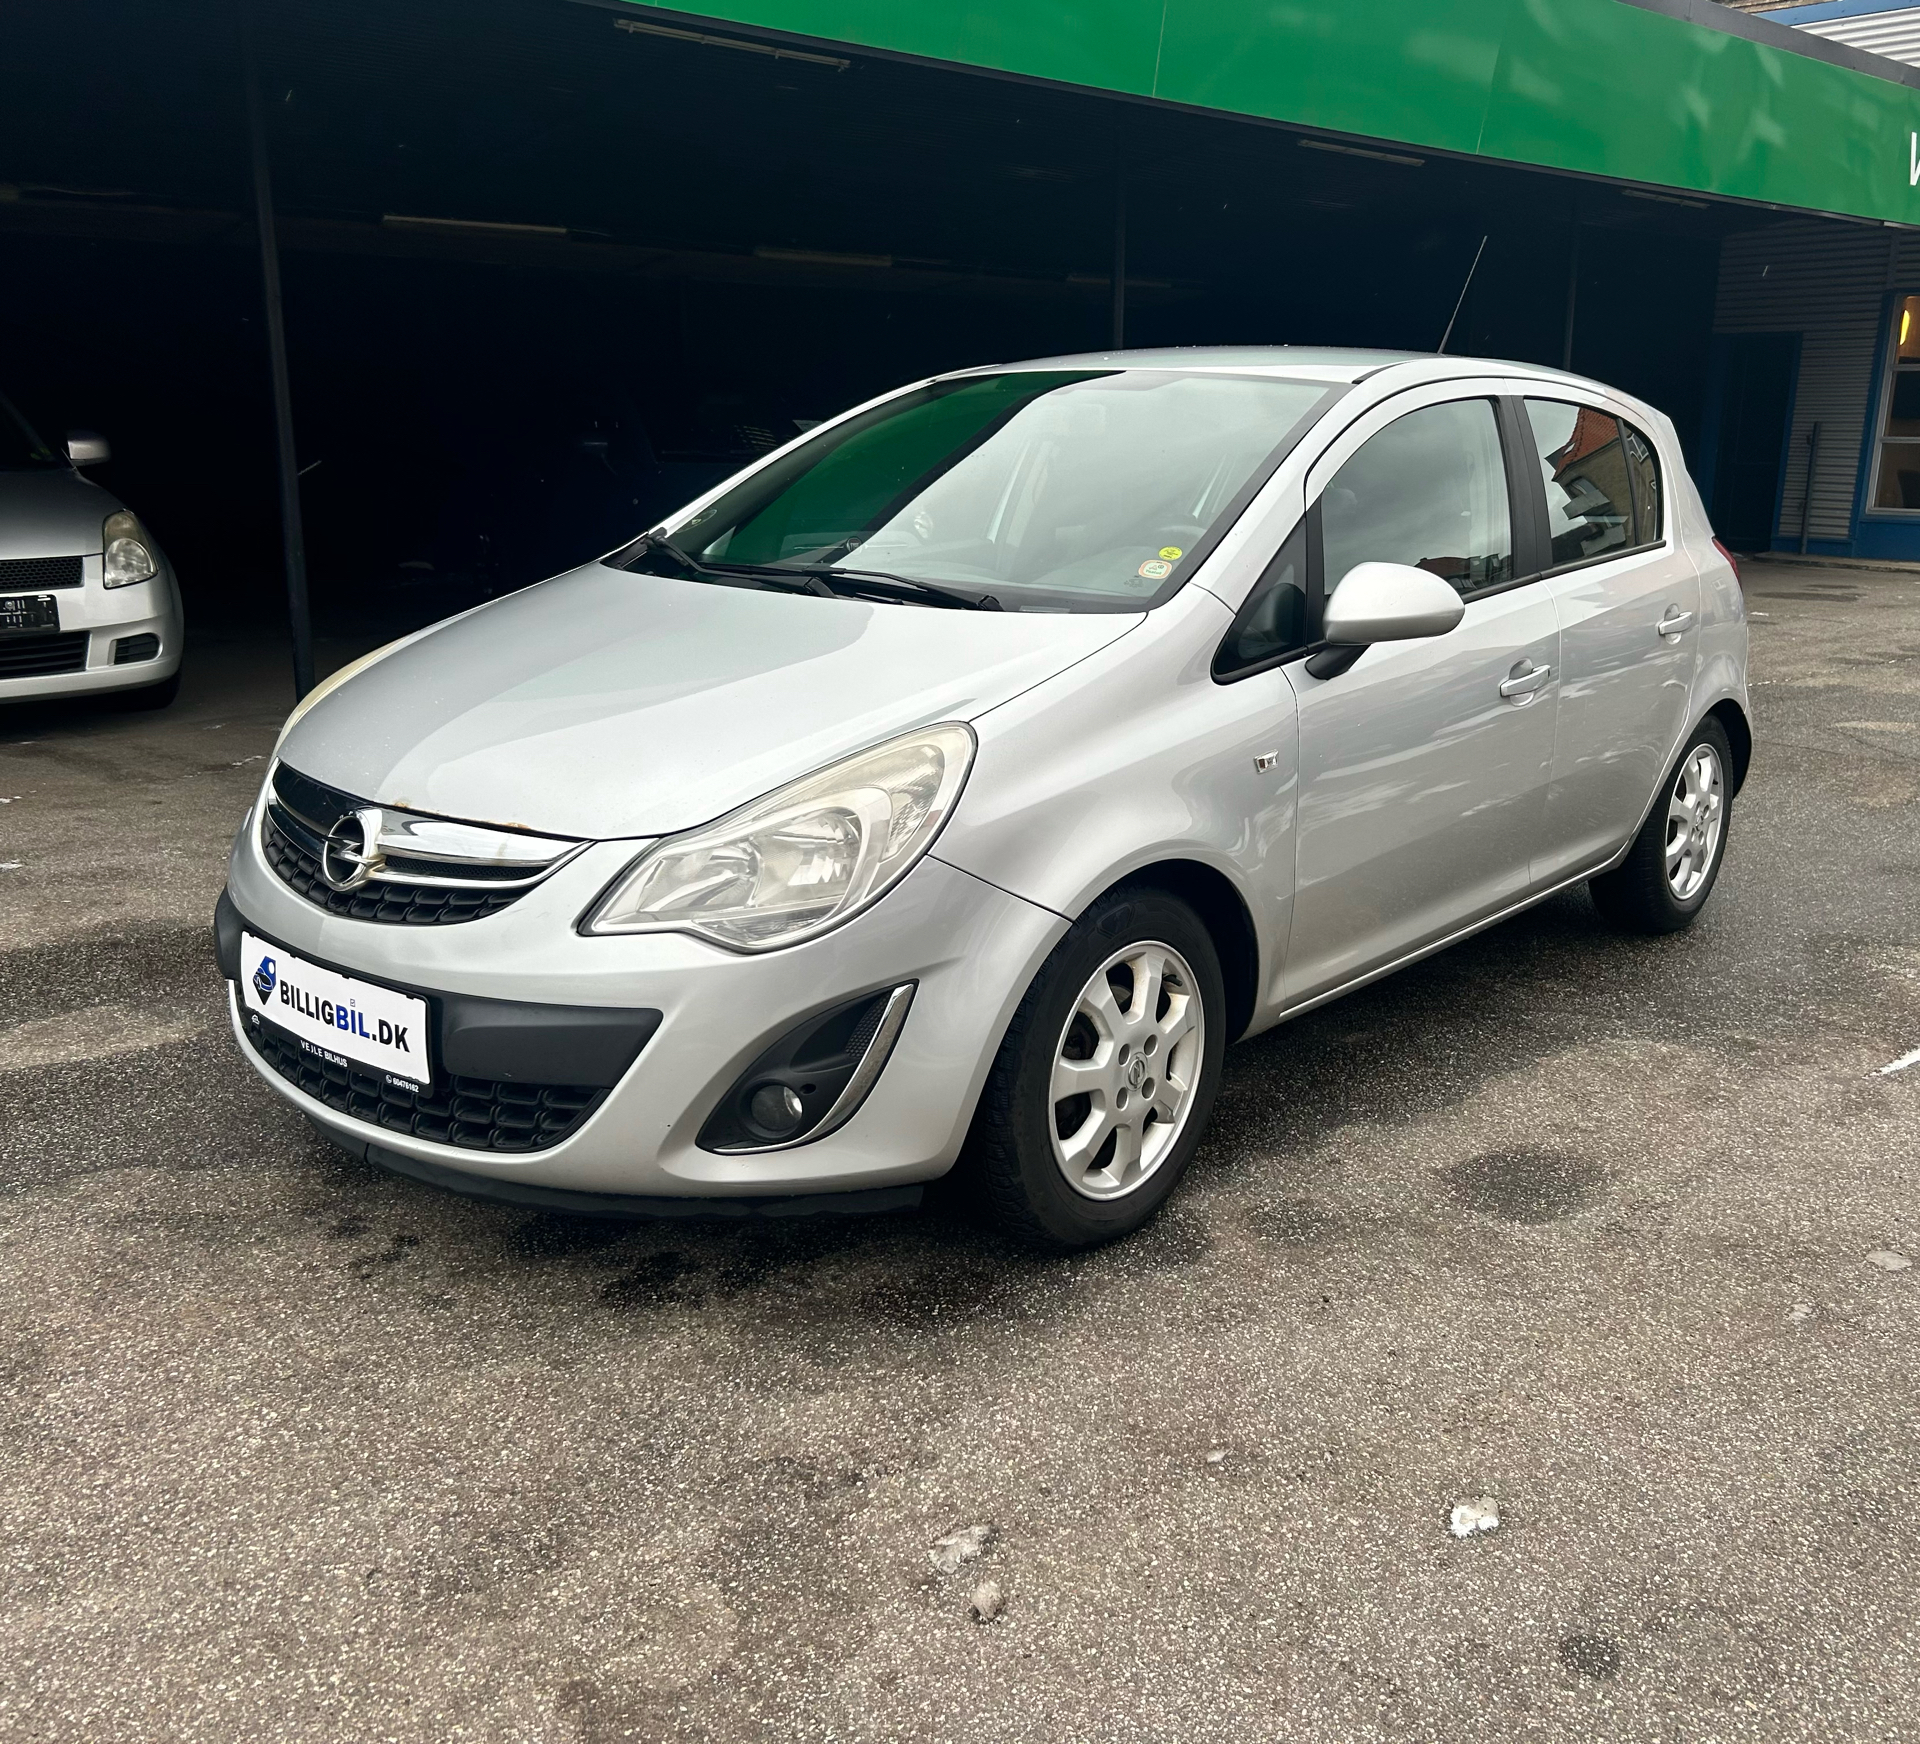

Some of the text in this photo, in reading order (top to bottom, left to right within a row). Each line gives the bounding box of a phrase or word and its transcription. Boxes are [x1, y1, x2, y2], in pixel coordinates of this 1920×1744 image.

[279, 979, 410, 1053] BILLIGBIL.DK
[300, 1039, 348, 1067] VEJLE BILHUS
